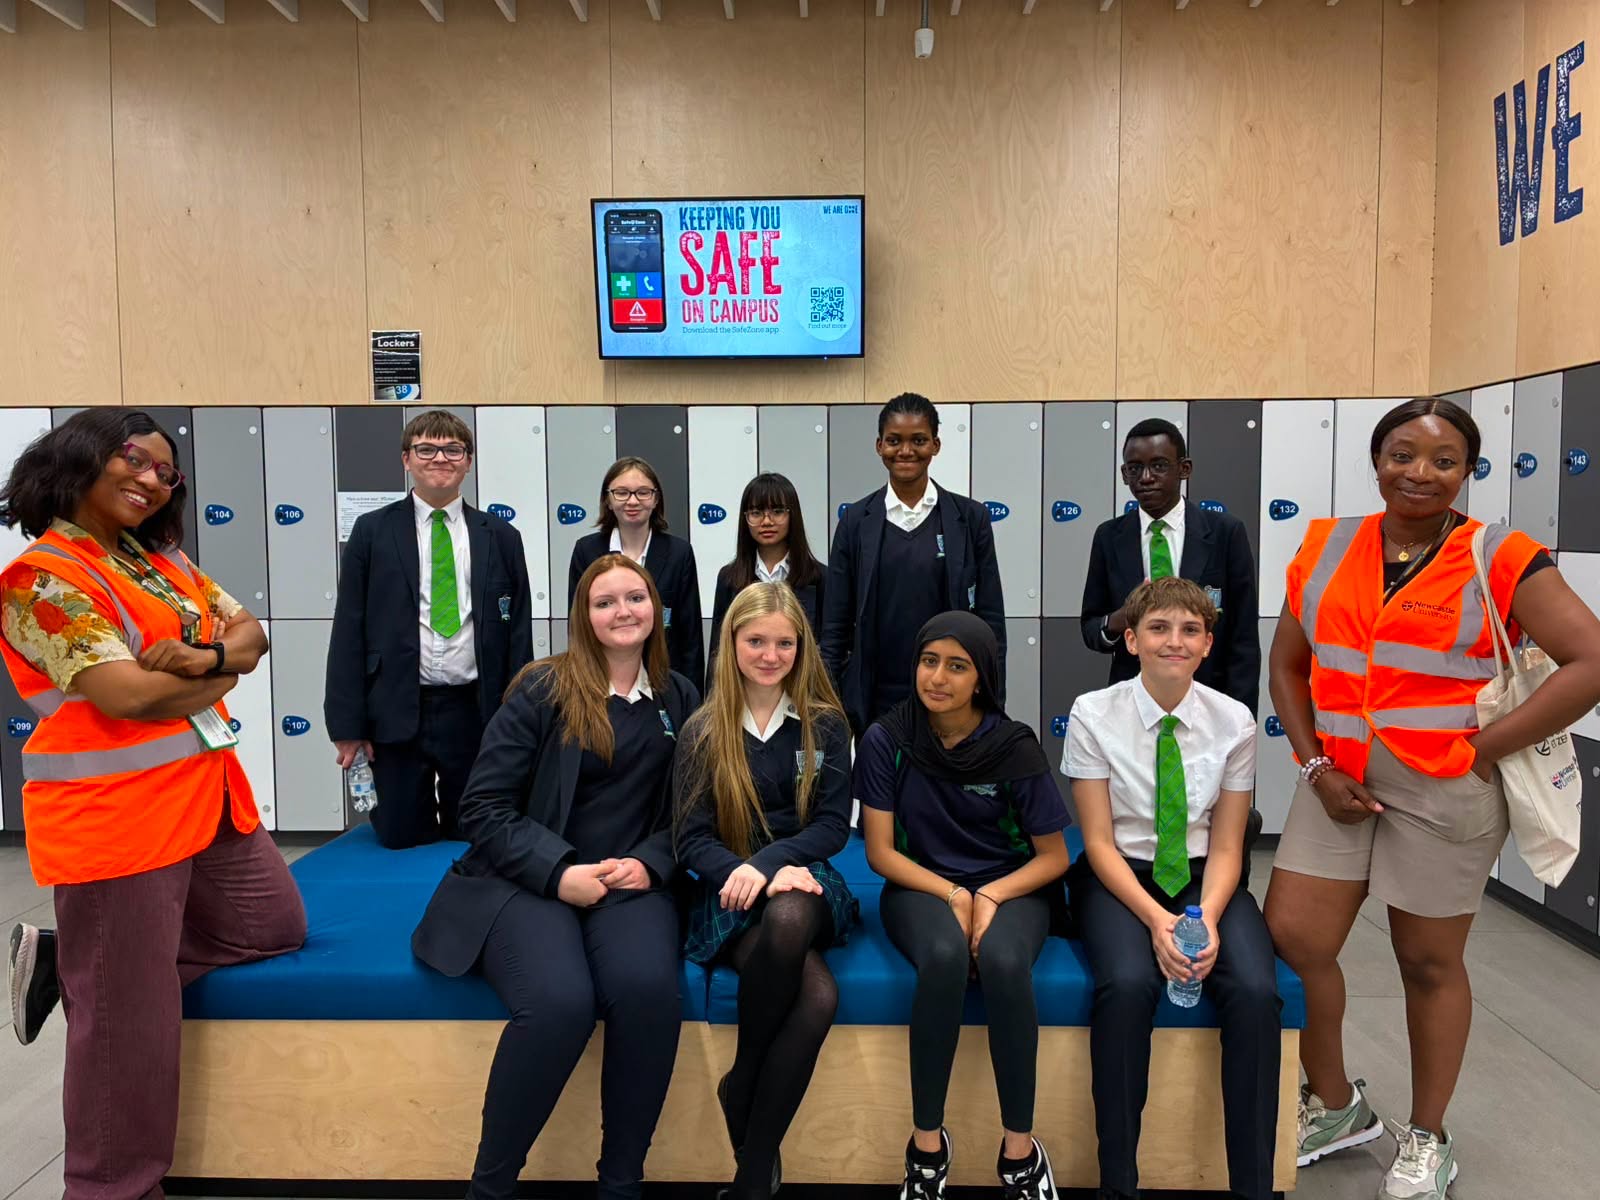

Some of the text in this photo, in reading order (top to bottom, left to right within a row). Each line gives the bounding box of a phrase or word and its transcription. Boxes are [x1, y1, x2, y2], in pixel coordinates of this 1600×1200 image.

[1493, 40, 1584, 246] WE
[679, 205, 780, 230] KEEPING YOU
[679, 230, 782, 296] SAFE
[682, 298, 779, 323] ON CAMPUS
[732, 326, 765, 334] SafeZone
[765, 327, 779, 335] app
[377, 339, 415, 347] Lockers
[395, 385, 408, 394] 38
[1573, 455, 1586, 465] 143
[990, 507, 1006, 515] 124
[1062, 507, 1078, 515] 126
[1279, 505, 1296, 513] 132
[214, 510, 230, 518] 104
[284, 510, 300, 518] 106
[497, 510, 512, 518] 110
[567, 510, 583, 518] 112
[707, 510, 723, 518] 116
[1414, 601, 1456, 614] Newcastle
[16, 722, 31, 730] 099
[291, 721, 307, 729] 107
